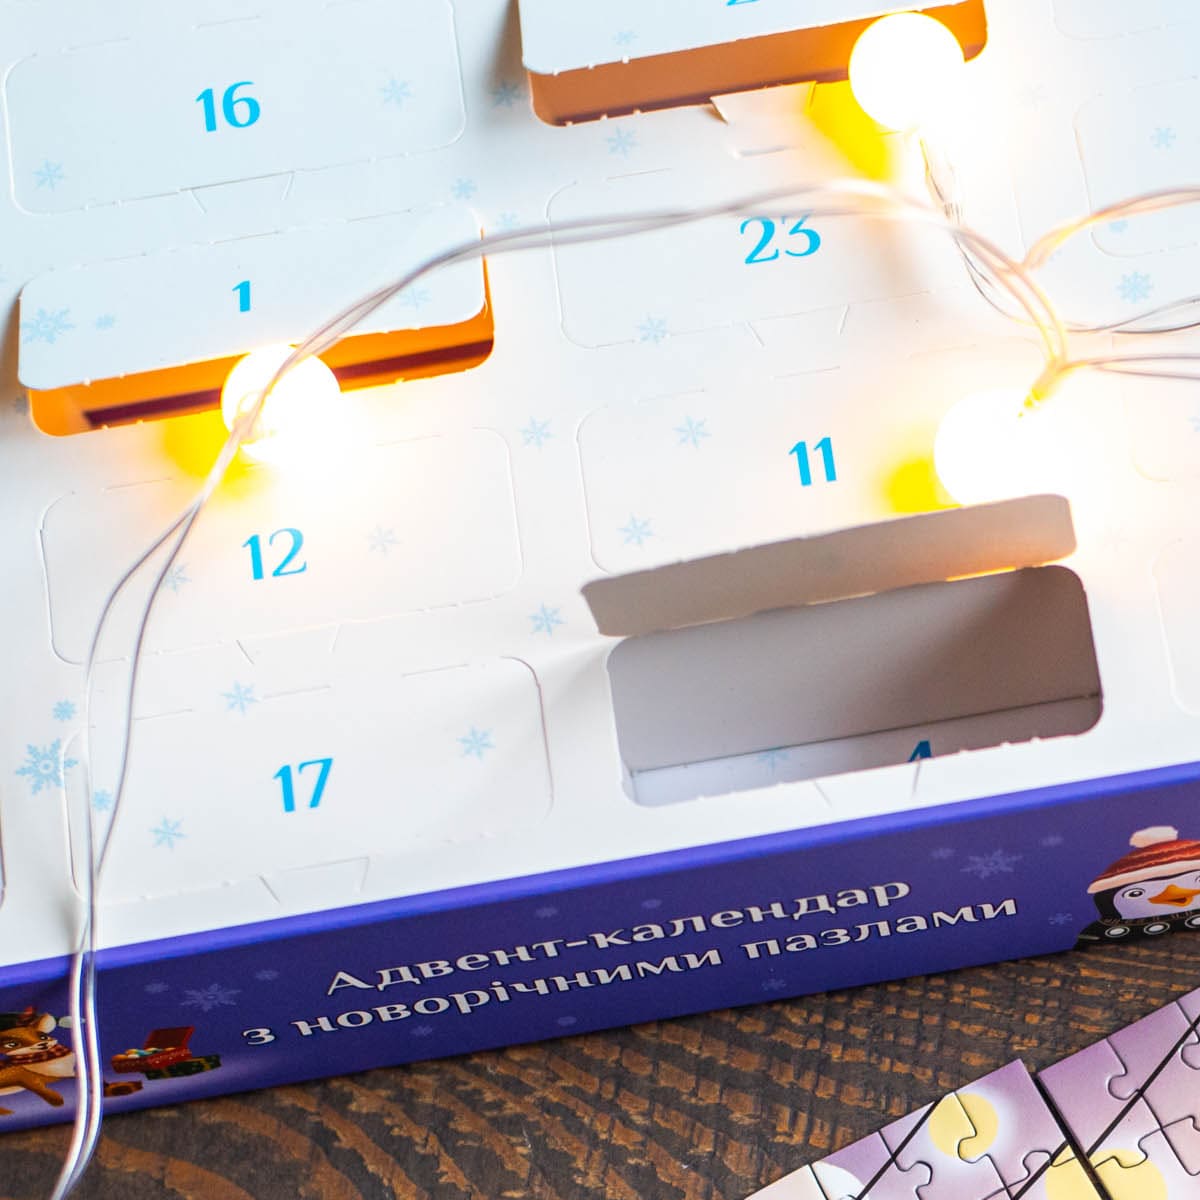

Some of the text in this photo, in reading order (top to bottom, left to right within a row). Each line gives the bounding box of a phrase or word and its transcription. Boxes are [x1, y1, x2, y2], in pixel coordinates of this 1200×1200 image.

[196, 81, 261, 132] 16
[739, 212, 821, 264] 23
[232, 280, 252, 312] 1
[788, 437, 837, 486] 11
[242, 528, 307, 580] 12
[273, 757, 333, 813] 17
[326, 881, 911, 996] Адвент-календар
[242, 897, 1018, 1046] з новорічними пазлами
